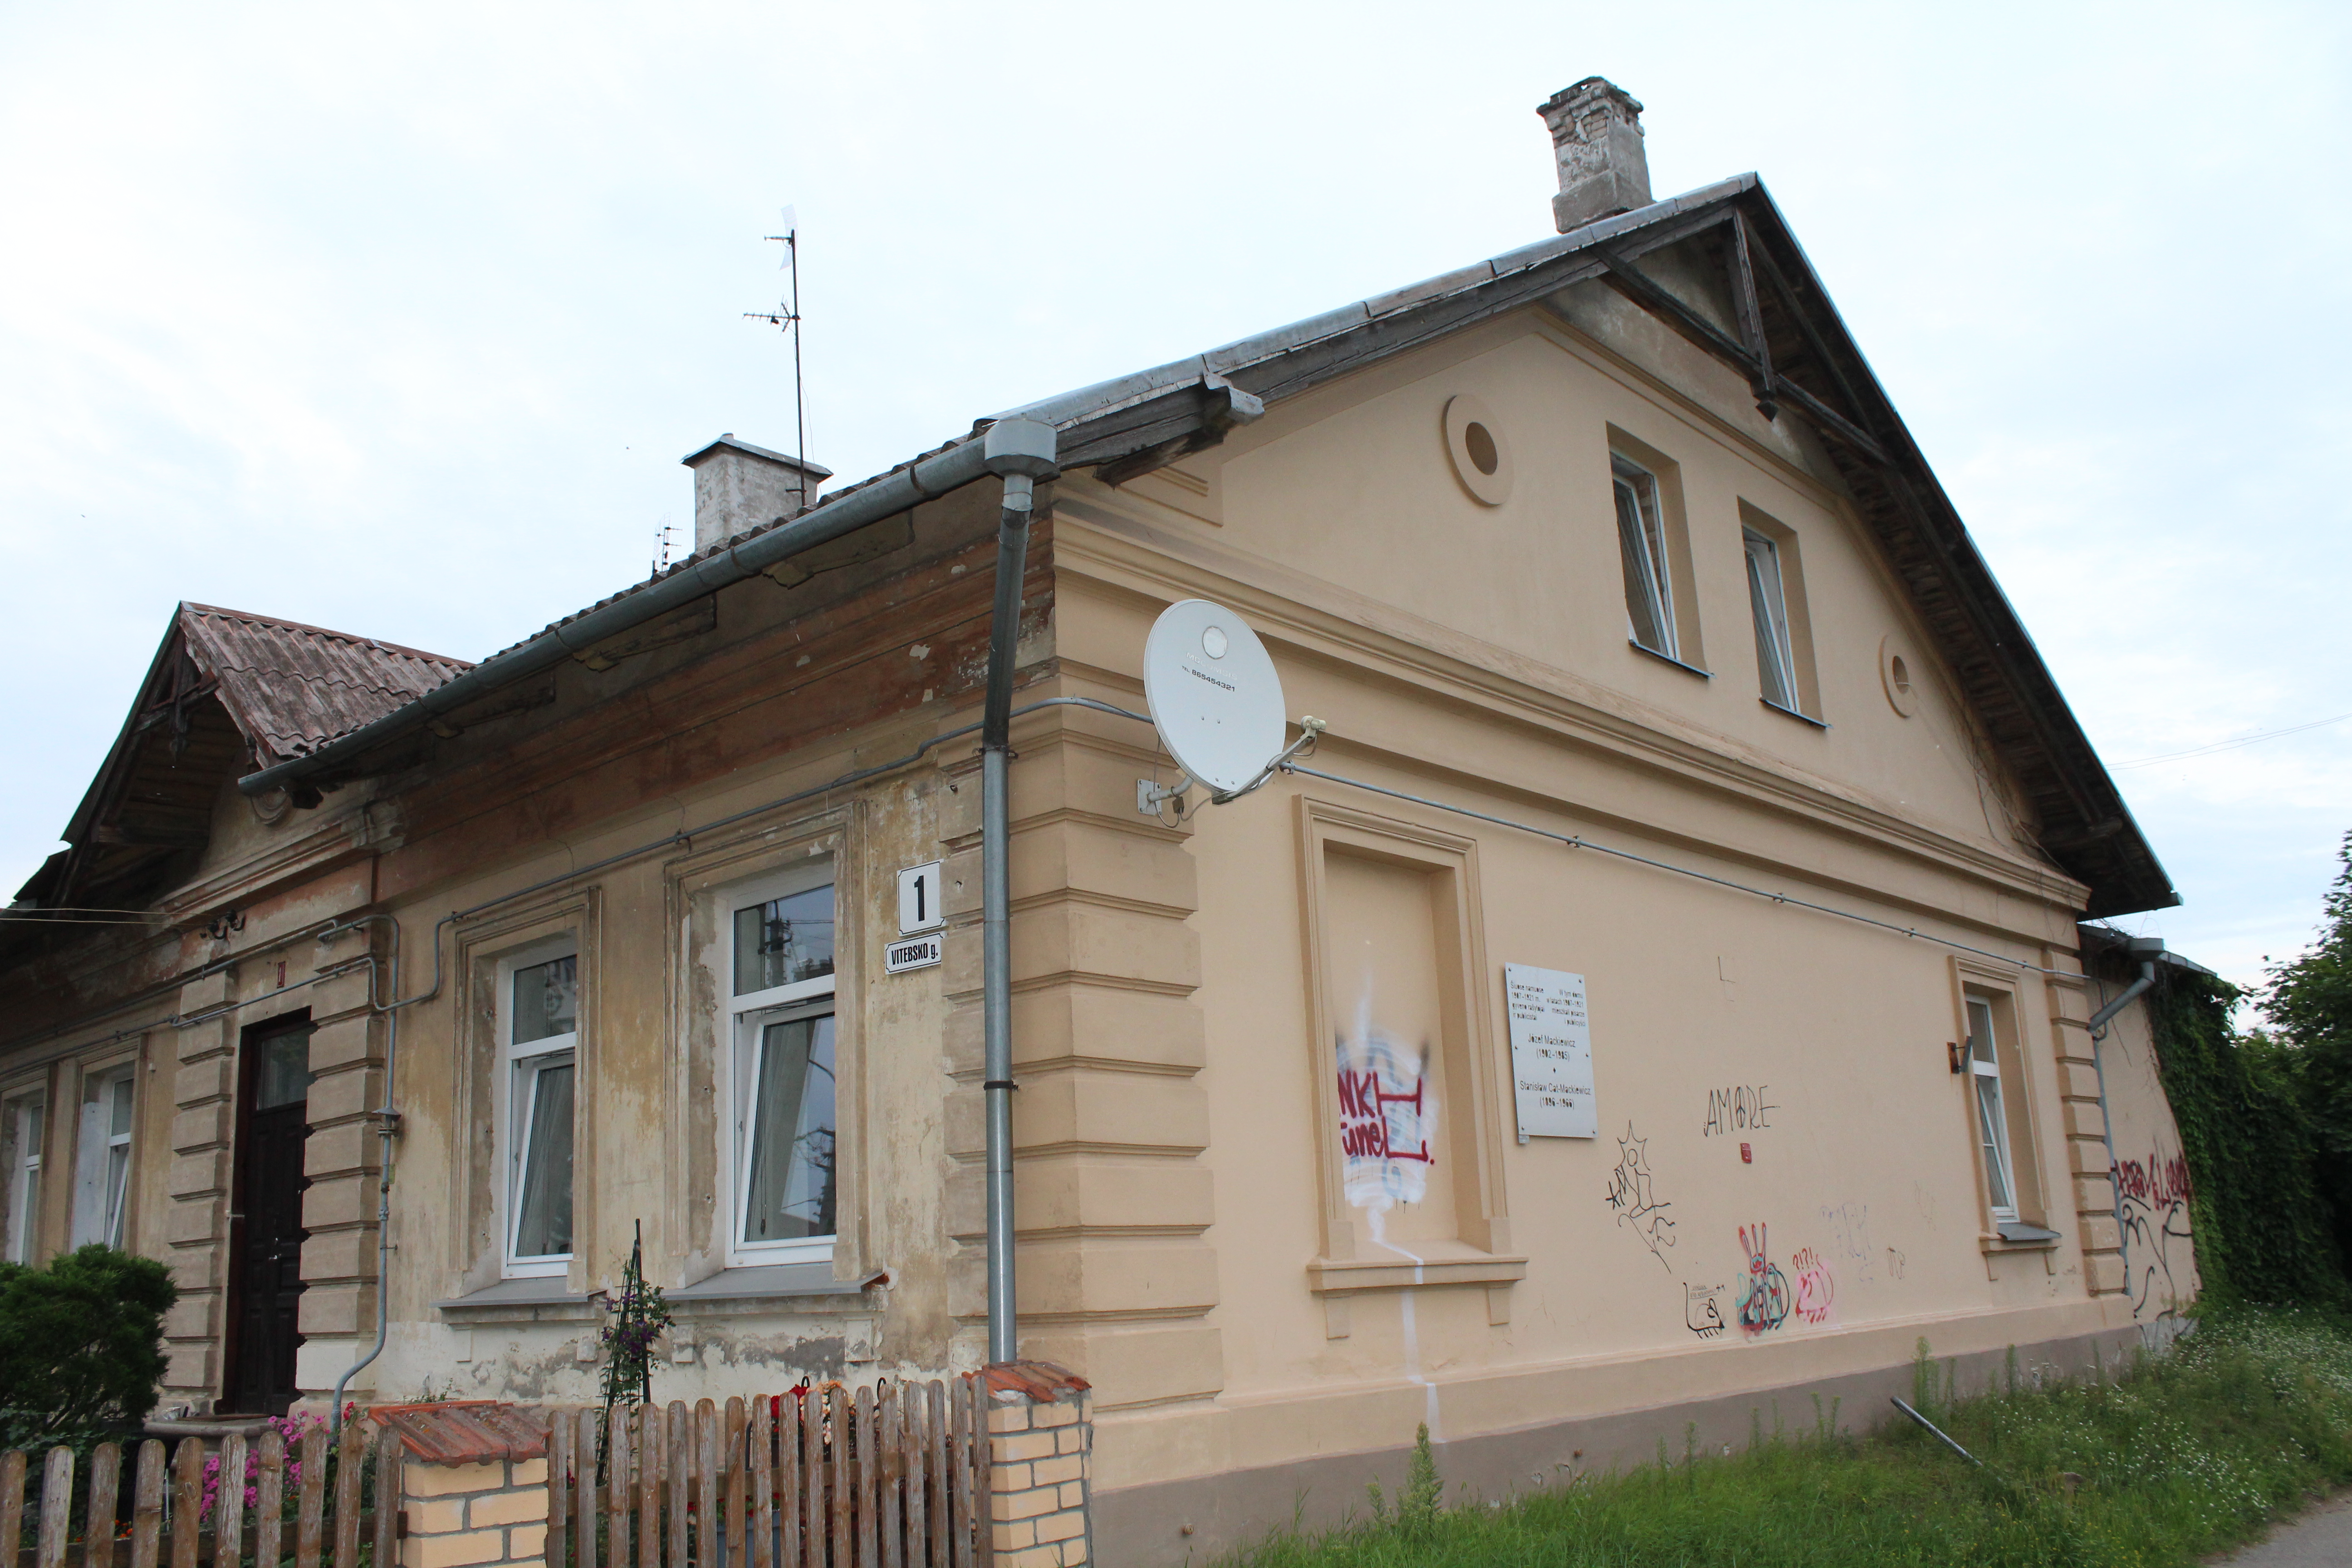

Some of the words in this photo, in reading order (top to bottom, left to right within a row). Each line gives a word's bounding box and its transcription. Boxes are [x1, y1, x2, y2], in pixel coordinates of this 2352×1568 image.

[1192, 669, 1235, 692] 865454321
[914, 874, 925, 922] 1
[891, 942, 928, 965] VITEBSKO
[931, 944, 938, 960] g.
[1528, 1033, 1543, 1044] Józef
[1544, 1034, 1576, 1048] Mackiewicz
[1519, 1080, 1547, 1092] Stanisław
[1548, 1083, 1591, 1095] Cat-Mackiewicz
[1704, 1084, 1780, 1137] AMORE
